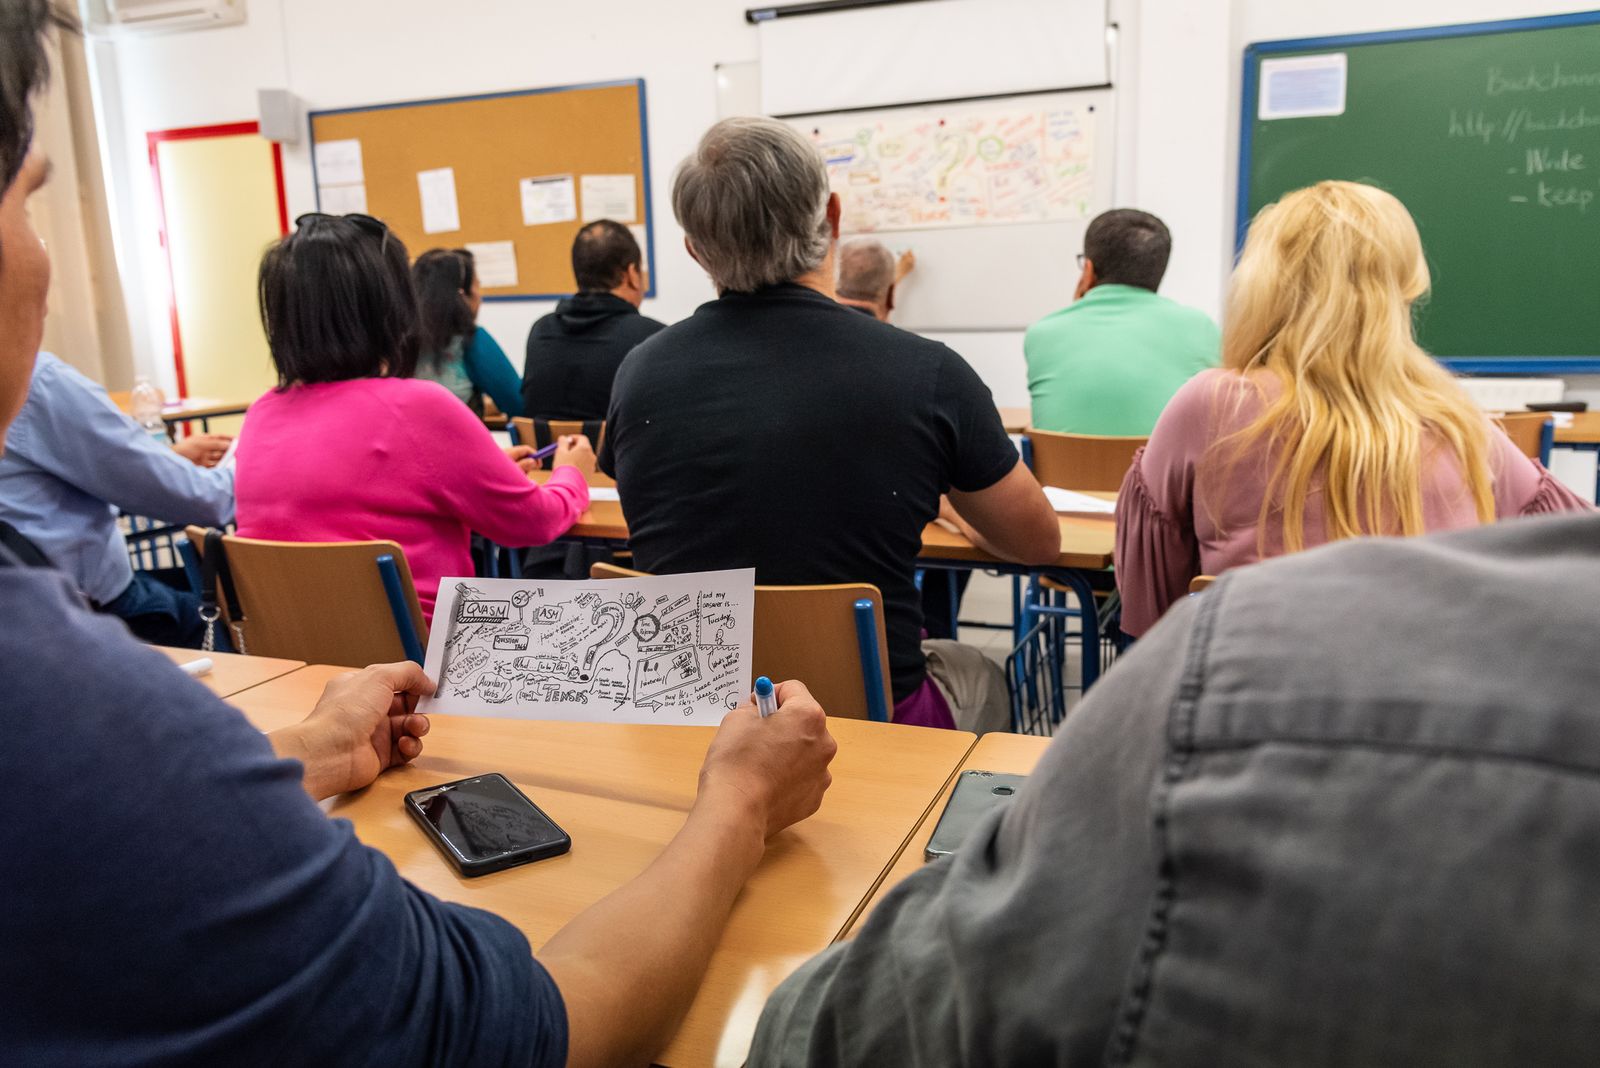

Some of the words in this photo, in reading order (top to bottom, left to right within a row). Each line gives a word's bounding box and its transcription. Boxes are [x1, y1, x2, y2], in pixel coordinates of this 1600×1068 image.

[715, 592, 726, 600] my
[539, 608, 559, 620] ASM
[483, 688, 500, 699] Verbs
[542, 683, 589, 705] TENSES
